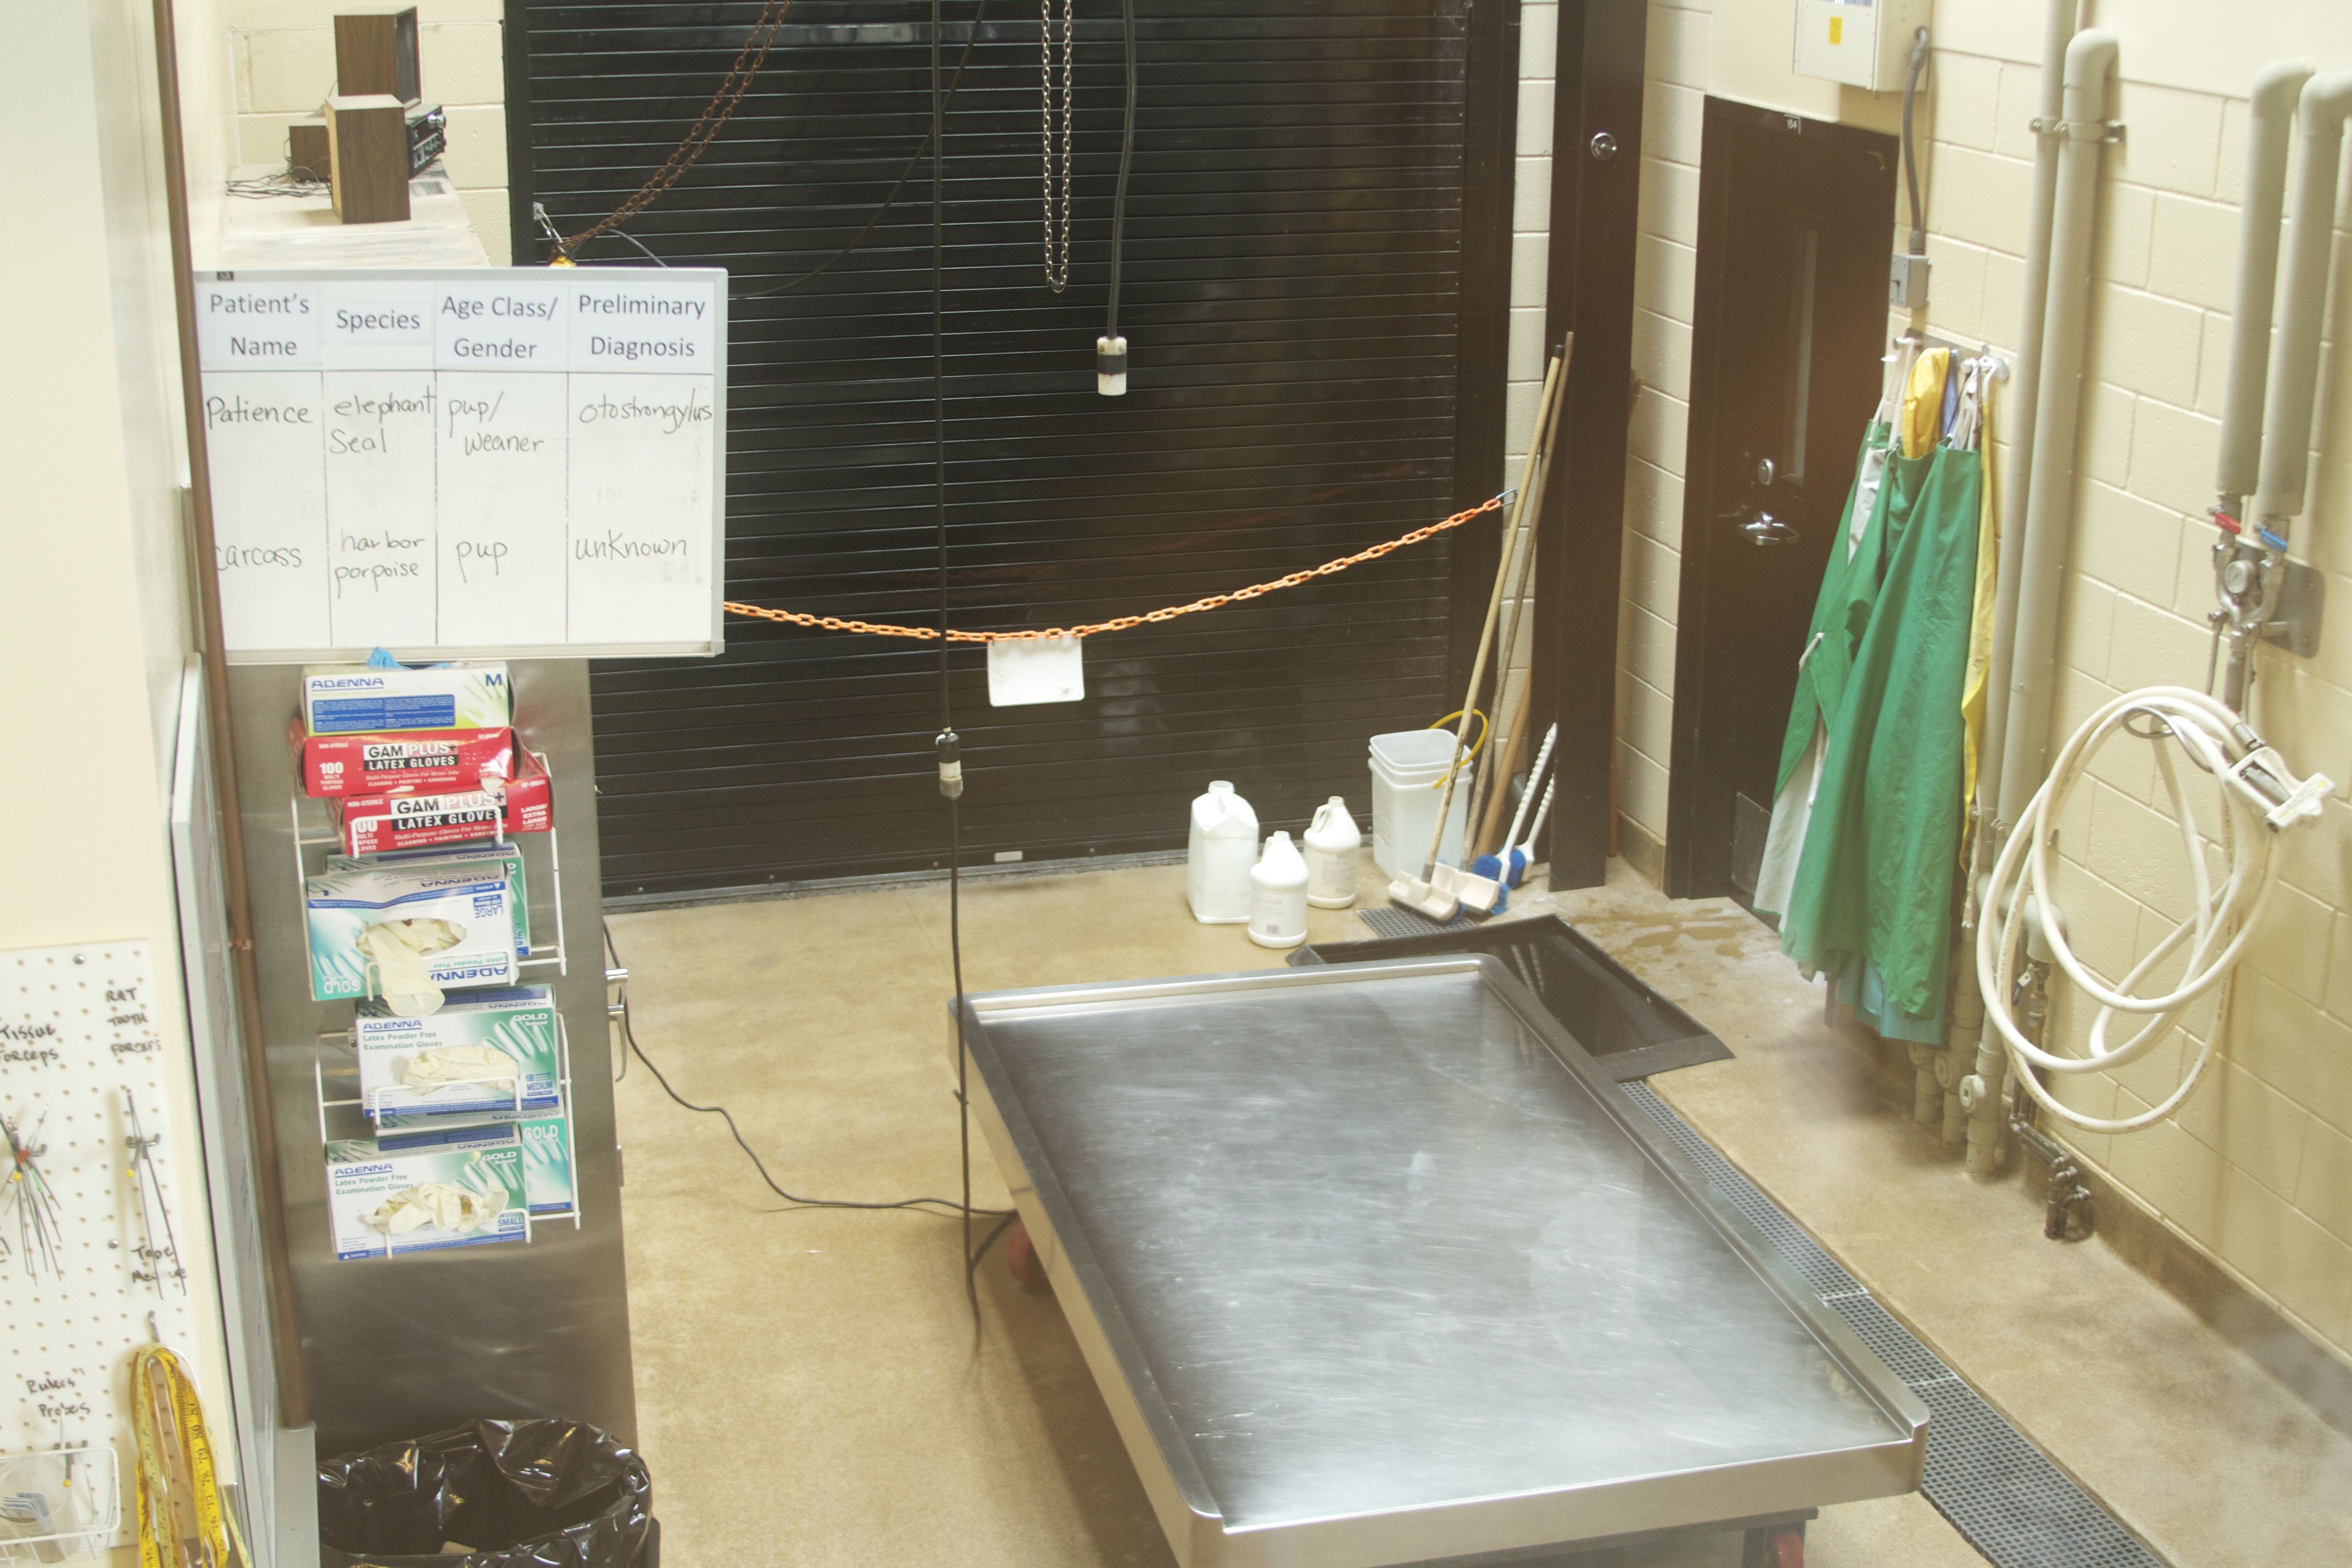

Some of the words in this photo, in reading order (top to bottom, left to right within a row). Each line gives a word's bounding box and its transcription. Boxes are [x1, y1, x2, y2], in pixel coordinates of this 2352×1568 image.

[210, 293, 310, 315] Patient's
[442, 296, 484, 322] Age
[491, 295, 559, 321] Class/
[579, 294, 706, 320] Preliminary
[337, 310, 421, 334] Species
[230, 338, 297, 357] Name
[454, 338, 537, 359] Gender
[591, 336, 696, 363] Diagnosis
[206, 395, 314, 429] Patience
[334, 385, 436, 425] elephant
[449, 392, 504, 438] pup/
[465, 434, 545, 456] weaner
[341, 528, 424, 552] harbor
[456, 541, 508, 583] pup
[334, 562, 419, 599] porpoise
[311, 677, 384, 688] ADENNA
[485, 673, 503, 686] M
[369, 745, 403, 758] GAM
[319, 762, 344, 774] 100
[369, 760, 406, 770] LATEX
[410, 756, 455, 767] GLOVES
[347, 799, 384, 808] NON-STERILE
[397, 797, 440, 813] GAM
[523, 810, 547, 818] EXTRA
[523, 816, 547, 824] LARGE
[349, 820, 378, 833] 00
[398, 815, 443, 830] LATEX
[397, 838, 427, 847] CLEANING
[421, 875, 499, 887] ADENNA
[474, 905, 504, 919] LARGE
[323, 979, 361, 994] GOLD
[513, 1012, 548, 1023] GOLD
[363, 1020, 422, 1030] ADENNA
[363, 1033, 385, 1041] Latex
[387, 1032, 418, 1040] Powder
[363, 1042, 413, 1050] Examination
[416, 1040, 443, 1049] Gloves
[527, 1080, 553, 1091] MEDIUM
[522, 1124, 559, 1140] GOLD
[481, 1151, 517, 1161] GOLD
[334, 1163, 393, 1175] ADENNA
[335, 1177, 357, 1186] Latex
[359, 1175, 389, 1184] Powder
[335, 1185, 386, 1195] Examination
[387, 1181, 414, 1191] Gloves
[497, 1215, 524, 1226] SMALL
